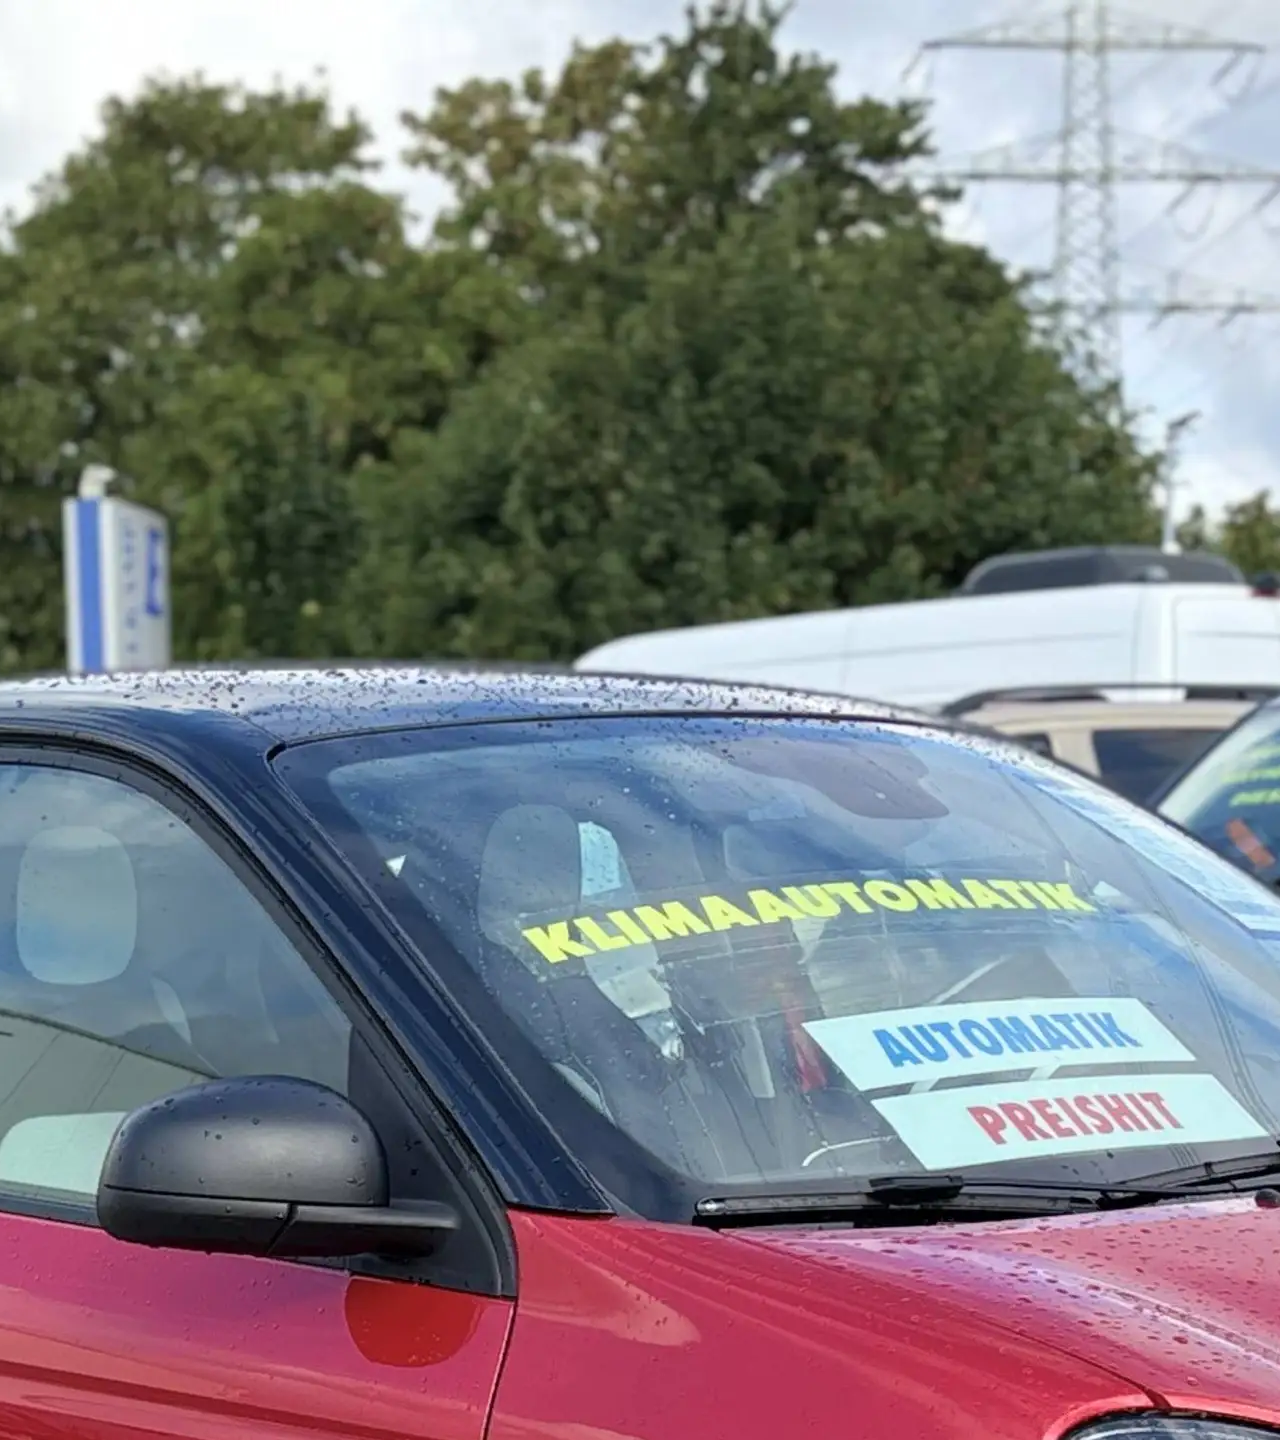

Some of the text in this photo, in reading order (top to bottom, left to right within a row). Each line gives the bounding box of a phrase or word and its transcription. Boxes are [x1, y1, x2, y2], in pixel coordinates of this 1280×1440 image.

[523, 879, 1098, 963] KLIMAAUTOMATIK
[873, 1012, 1143, 1068] AUTOMATIK
[966, 1091, 1184, 1146] PREISHIT
